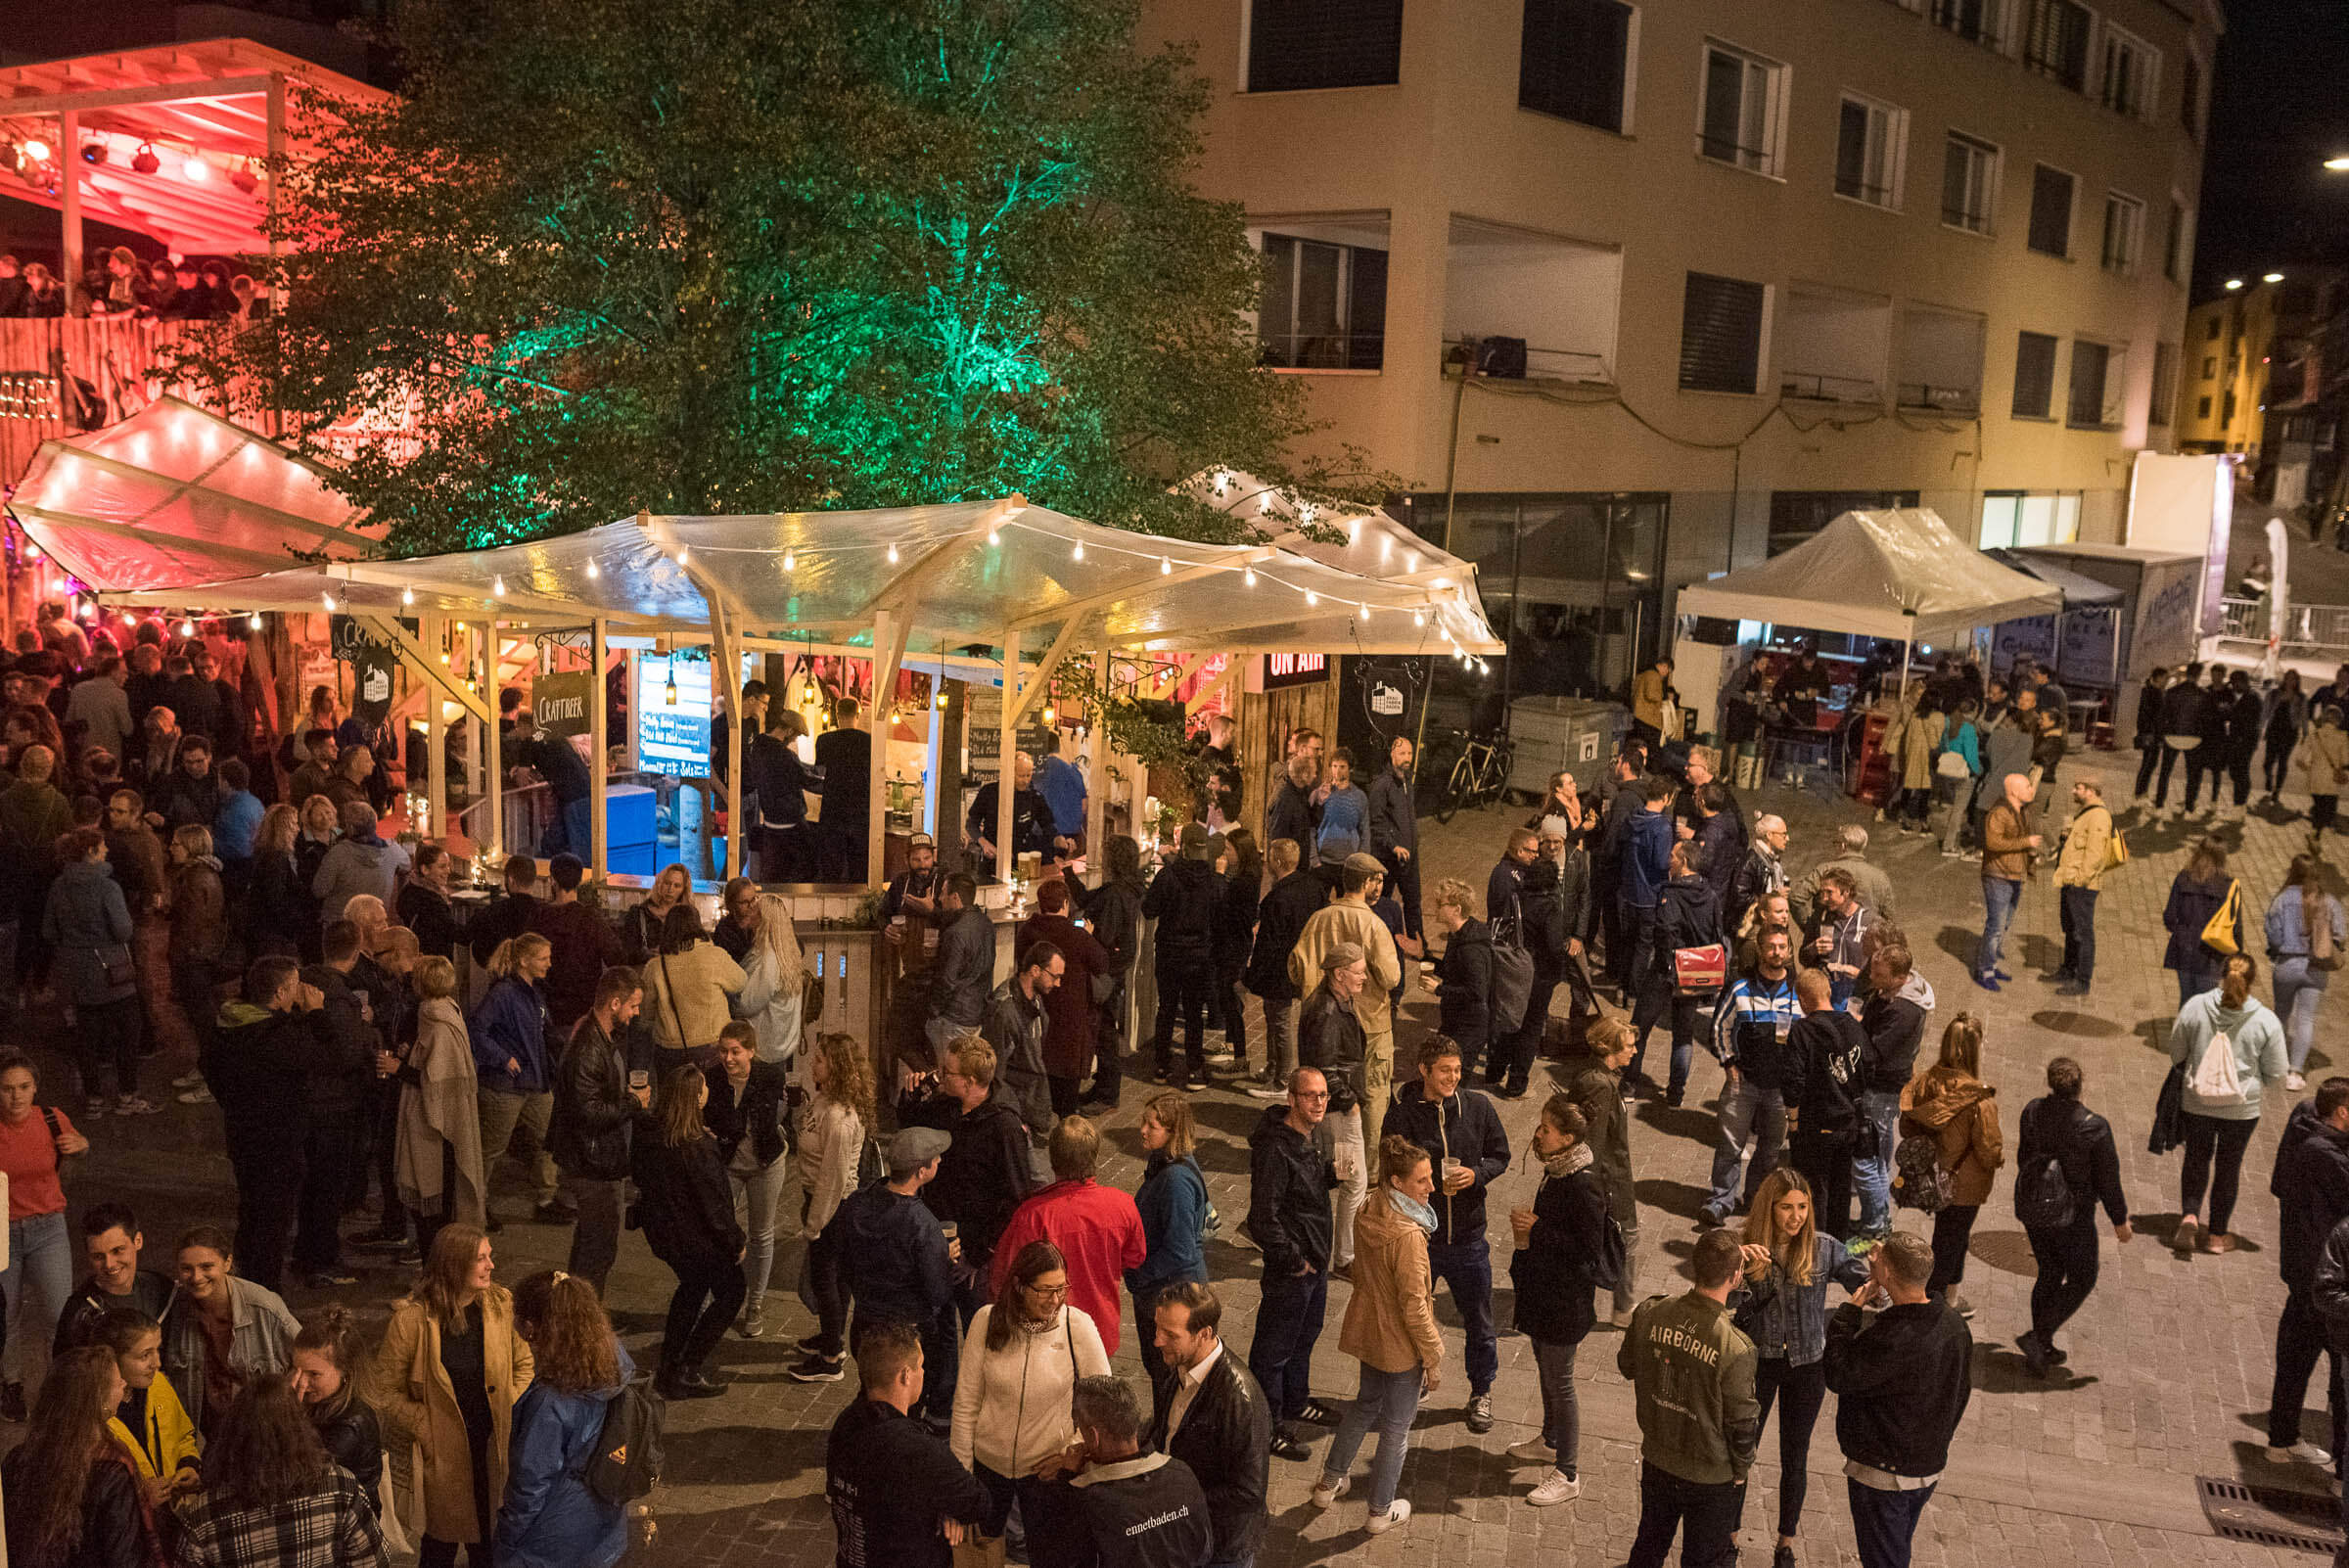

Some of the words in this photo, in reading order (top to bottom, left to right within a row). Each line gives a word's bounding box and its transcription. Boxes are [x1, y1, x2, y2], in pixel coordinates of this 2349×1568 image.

[539, 696, 583, 724] CRAFTBEER
[1649, 1325, 1720, 1367] AIRBORNE
[1126, 1504, 1189, 1537] ennetbaden.ch
